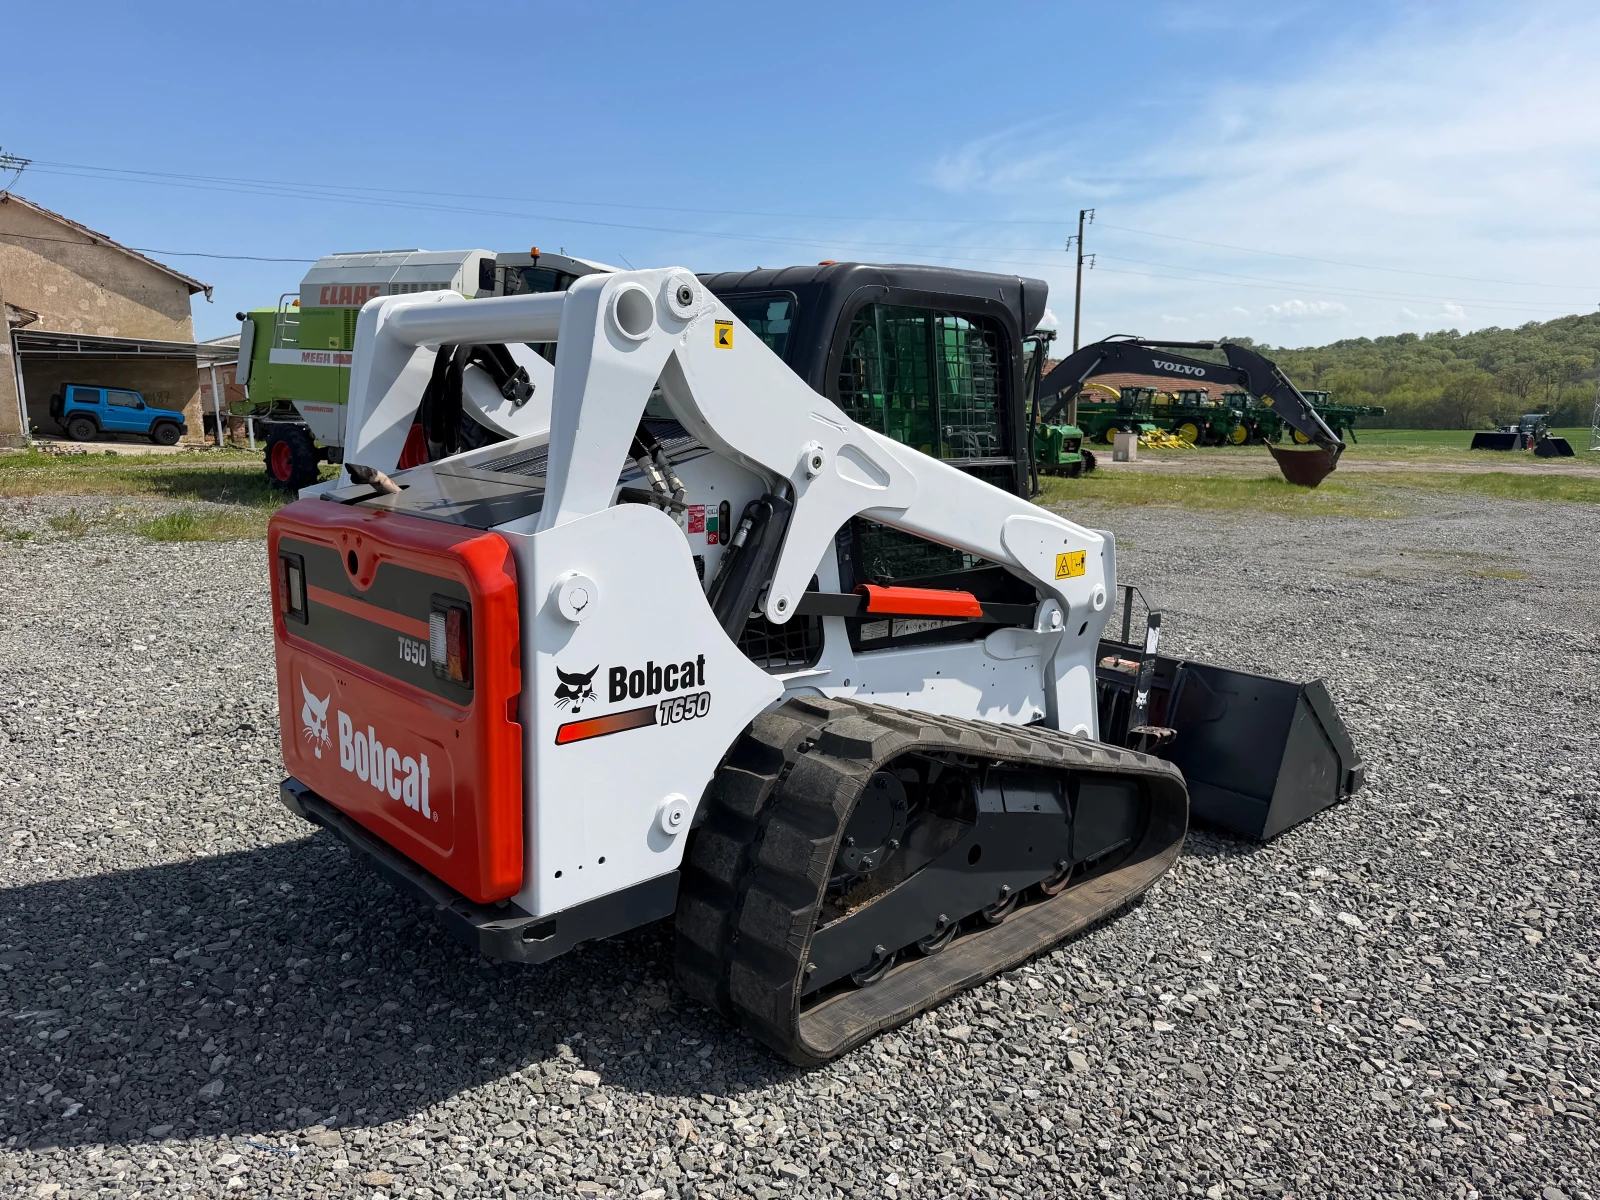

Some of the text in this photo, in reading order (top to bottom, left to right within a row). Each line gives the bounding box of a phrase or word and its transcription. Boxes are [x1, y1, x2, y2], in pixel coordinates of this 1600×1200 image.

[301, 352, 330, 363] MEGA
[1152, 359, 1206, 376] VOLVO
[303, 405, 333, 413] DOMINATOR
[397, 636, 427, 667] T650
[608, 654, 705, 703] Bobcat
[659, 691, 711, 726] T650
[337, 709, 431, 819] Bobcat
